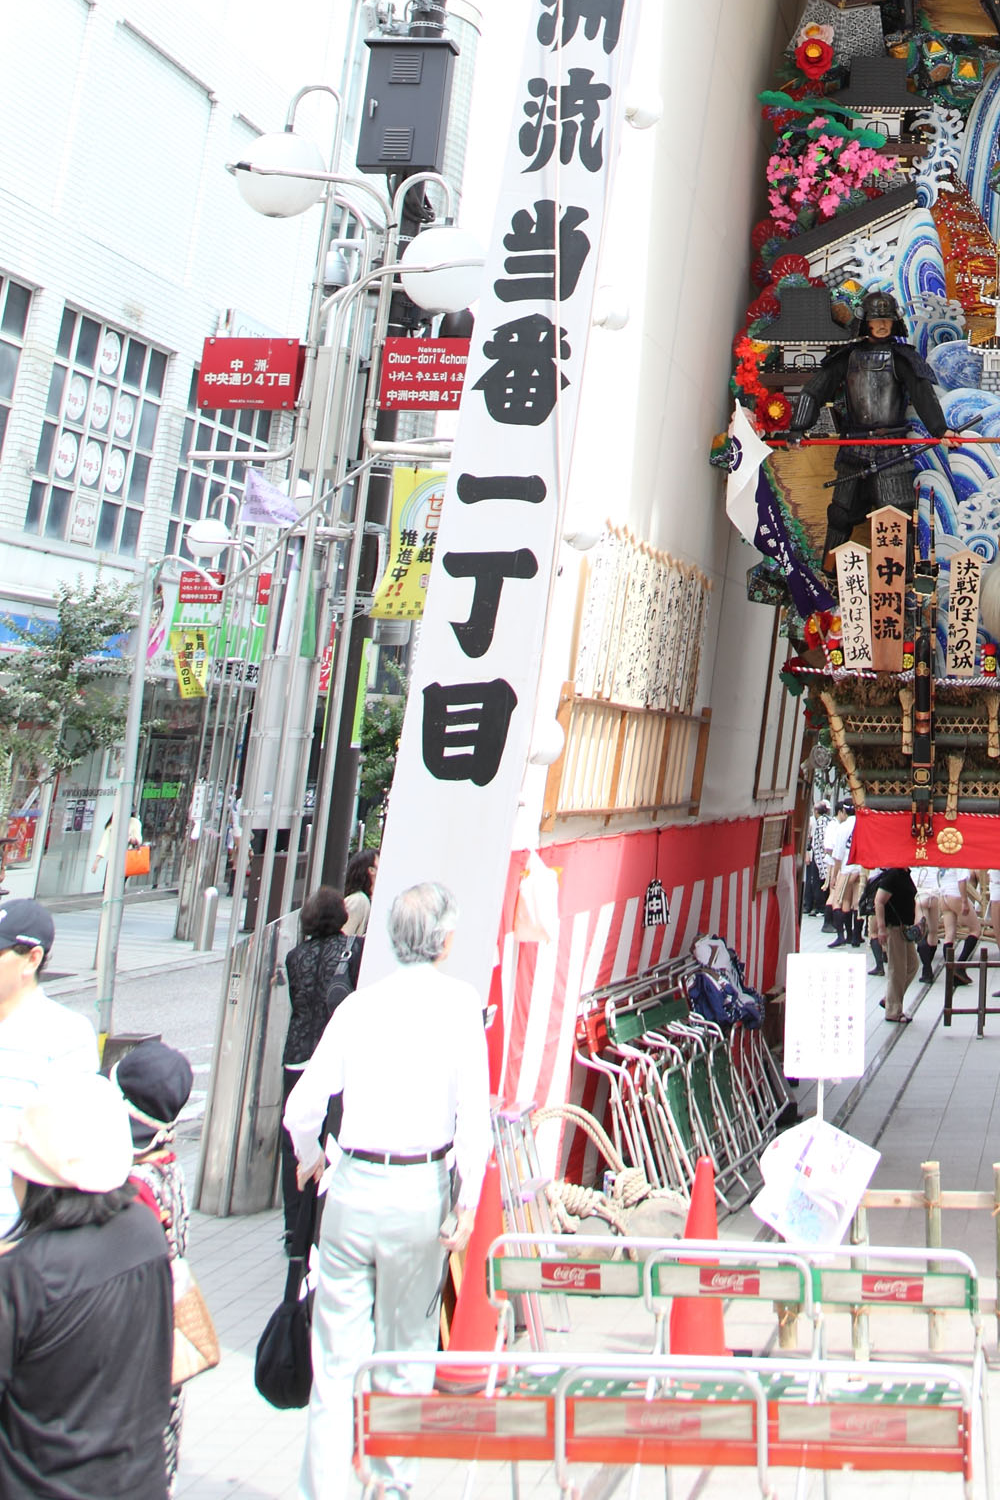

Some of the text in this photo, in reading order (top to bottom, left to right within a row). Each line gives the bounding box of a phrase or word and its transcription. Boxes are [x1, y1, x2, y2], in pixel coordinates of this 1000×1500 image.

[230, 359, 268, 372] 中洲
[388, 353, 436, 364] Chuo-dori
[388, 371, 413, 382] 나카스
[843, 551, 872, 661] 決戦のぼうの城
[873, 557, 905, 641] 中洲流
[952, 558, 979, 669] 決戦のぼうの城
